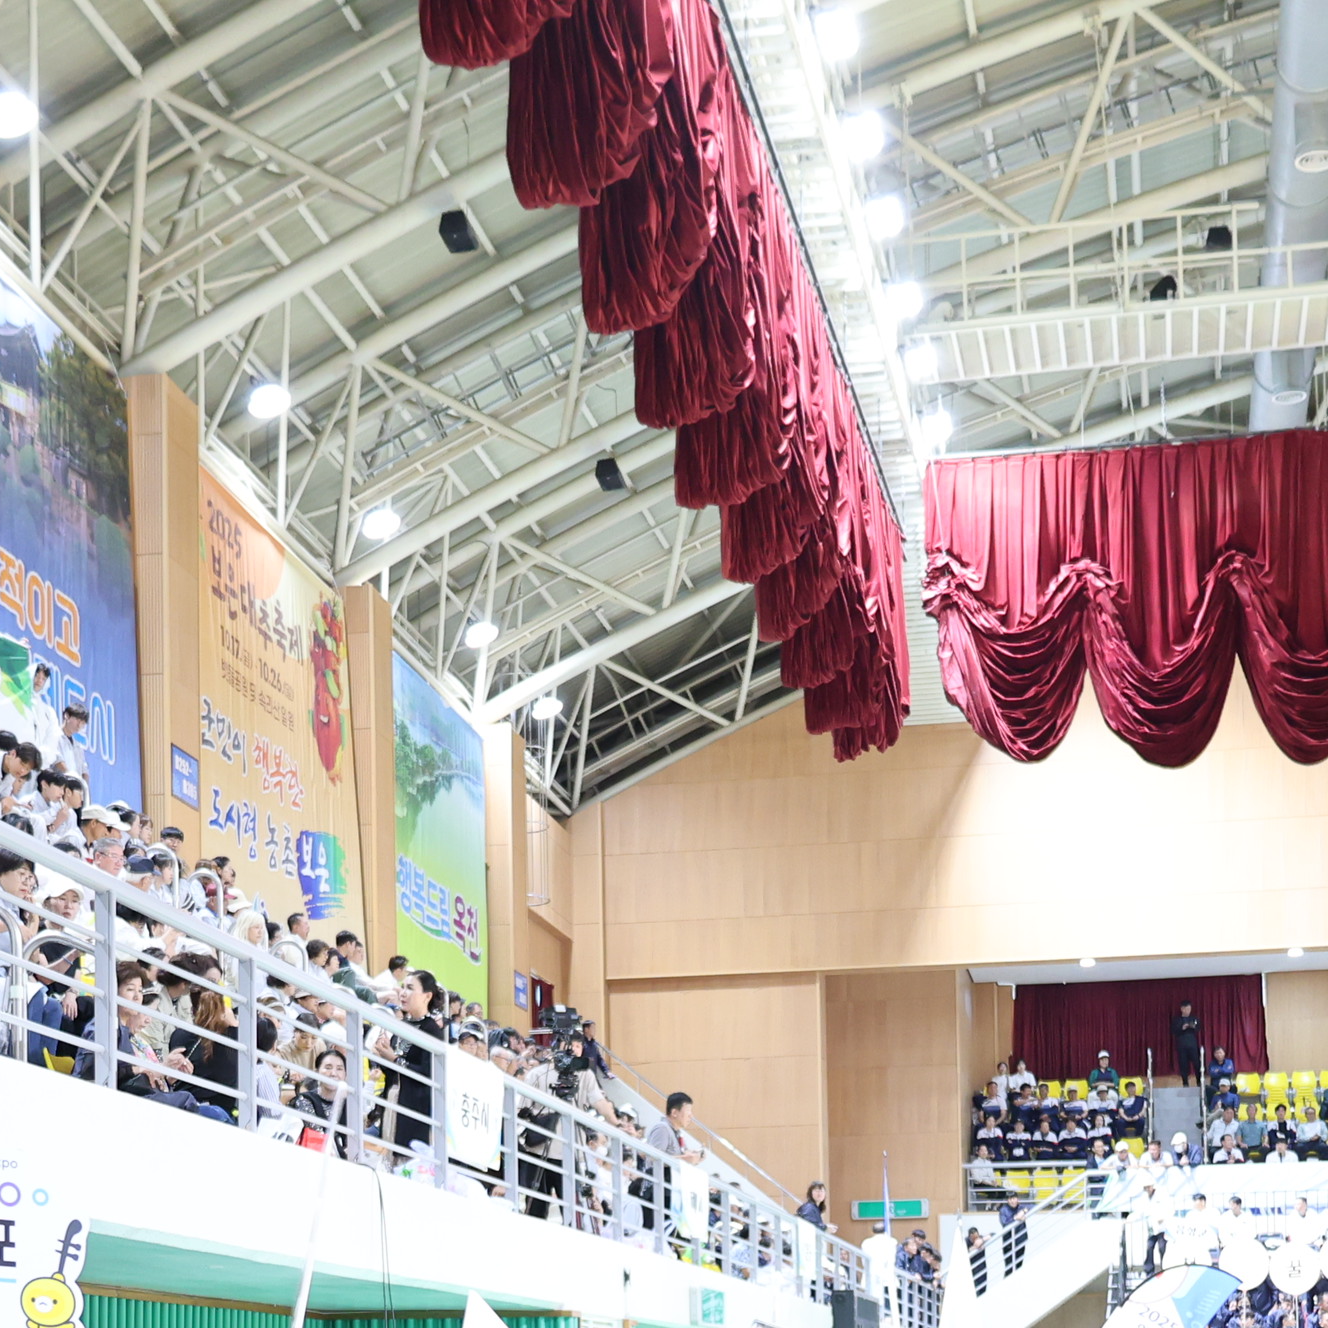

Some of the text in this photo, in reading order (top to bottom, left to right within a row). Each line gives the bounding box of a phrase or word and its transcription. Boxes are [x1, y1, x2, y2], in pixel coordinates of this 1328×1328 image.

[207, 500, 242, 559] 2025
[254, 736, 304, 809] 행복한
[209, 788, 258, 860] 도시형
[301, 835, 332, 893] 보은
[397, 855, 482, 962] 행복드림 옥천
[461, 1092, 490, 1134] 충주시
